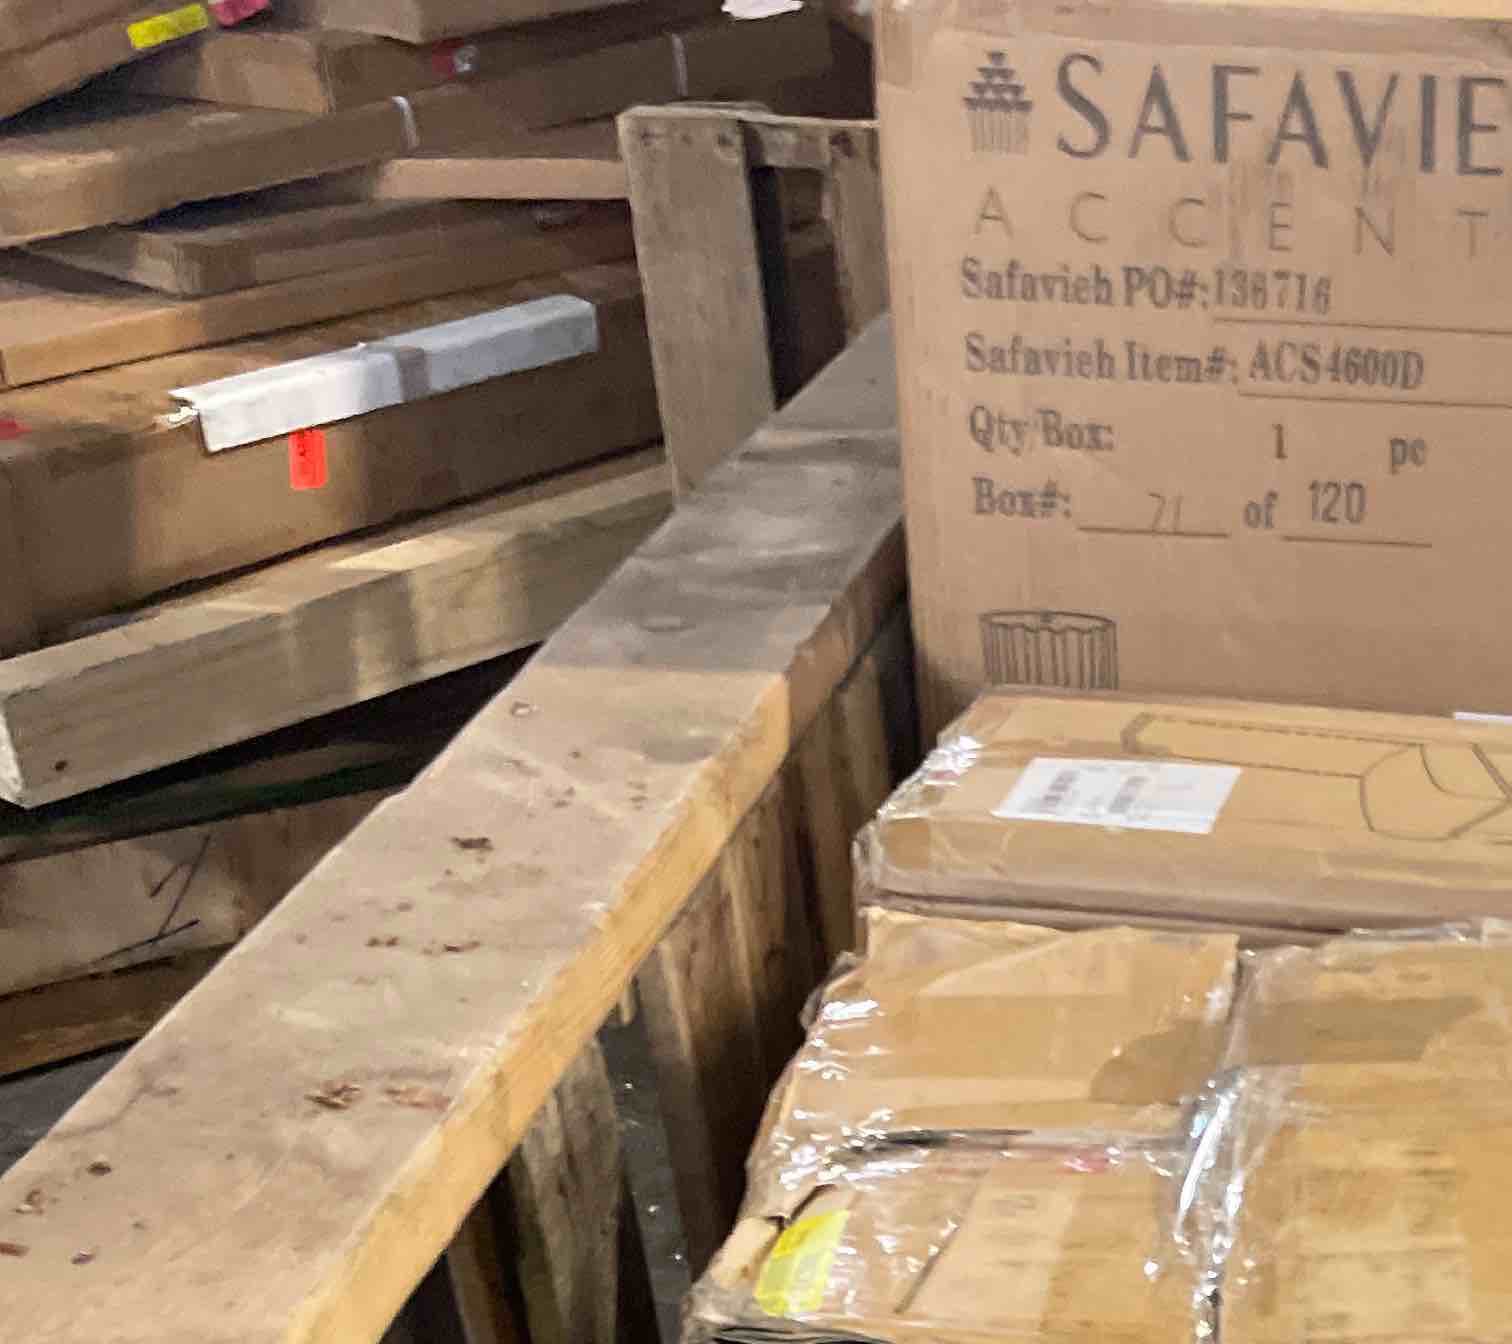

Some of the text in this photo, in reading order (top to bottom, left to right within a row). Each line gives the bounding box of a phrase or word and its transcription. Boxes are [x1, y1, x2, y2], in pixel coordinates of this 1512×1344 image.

[1271, 423, 1288, 460] 1
[1244, 490, 1279, 529] of
[1307, 479, 1368, 525] 120
